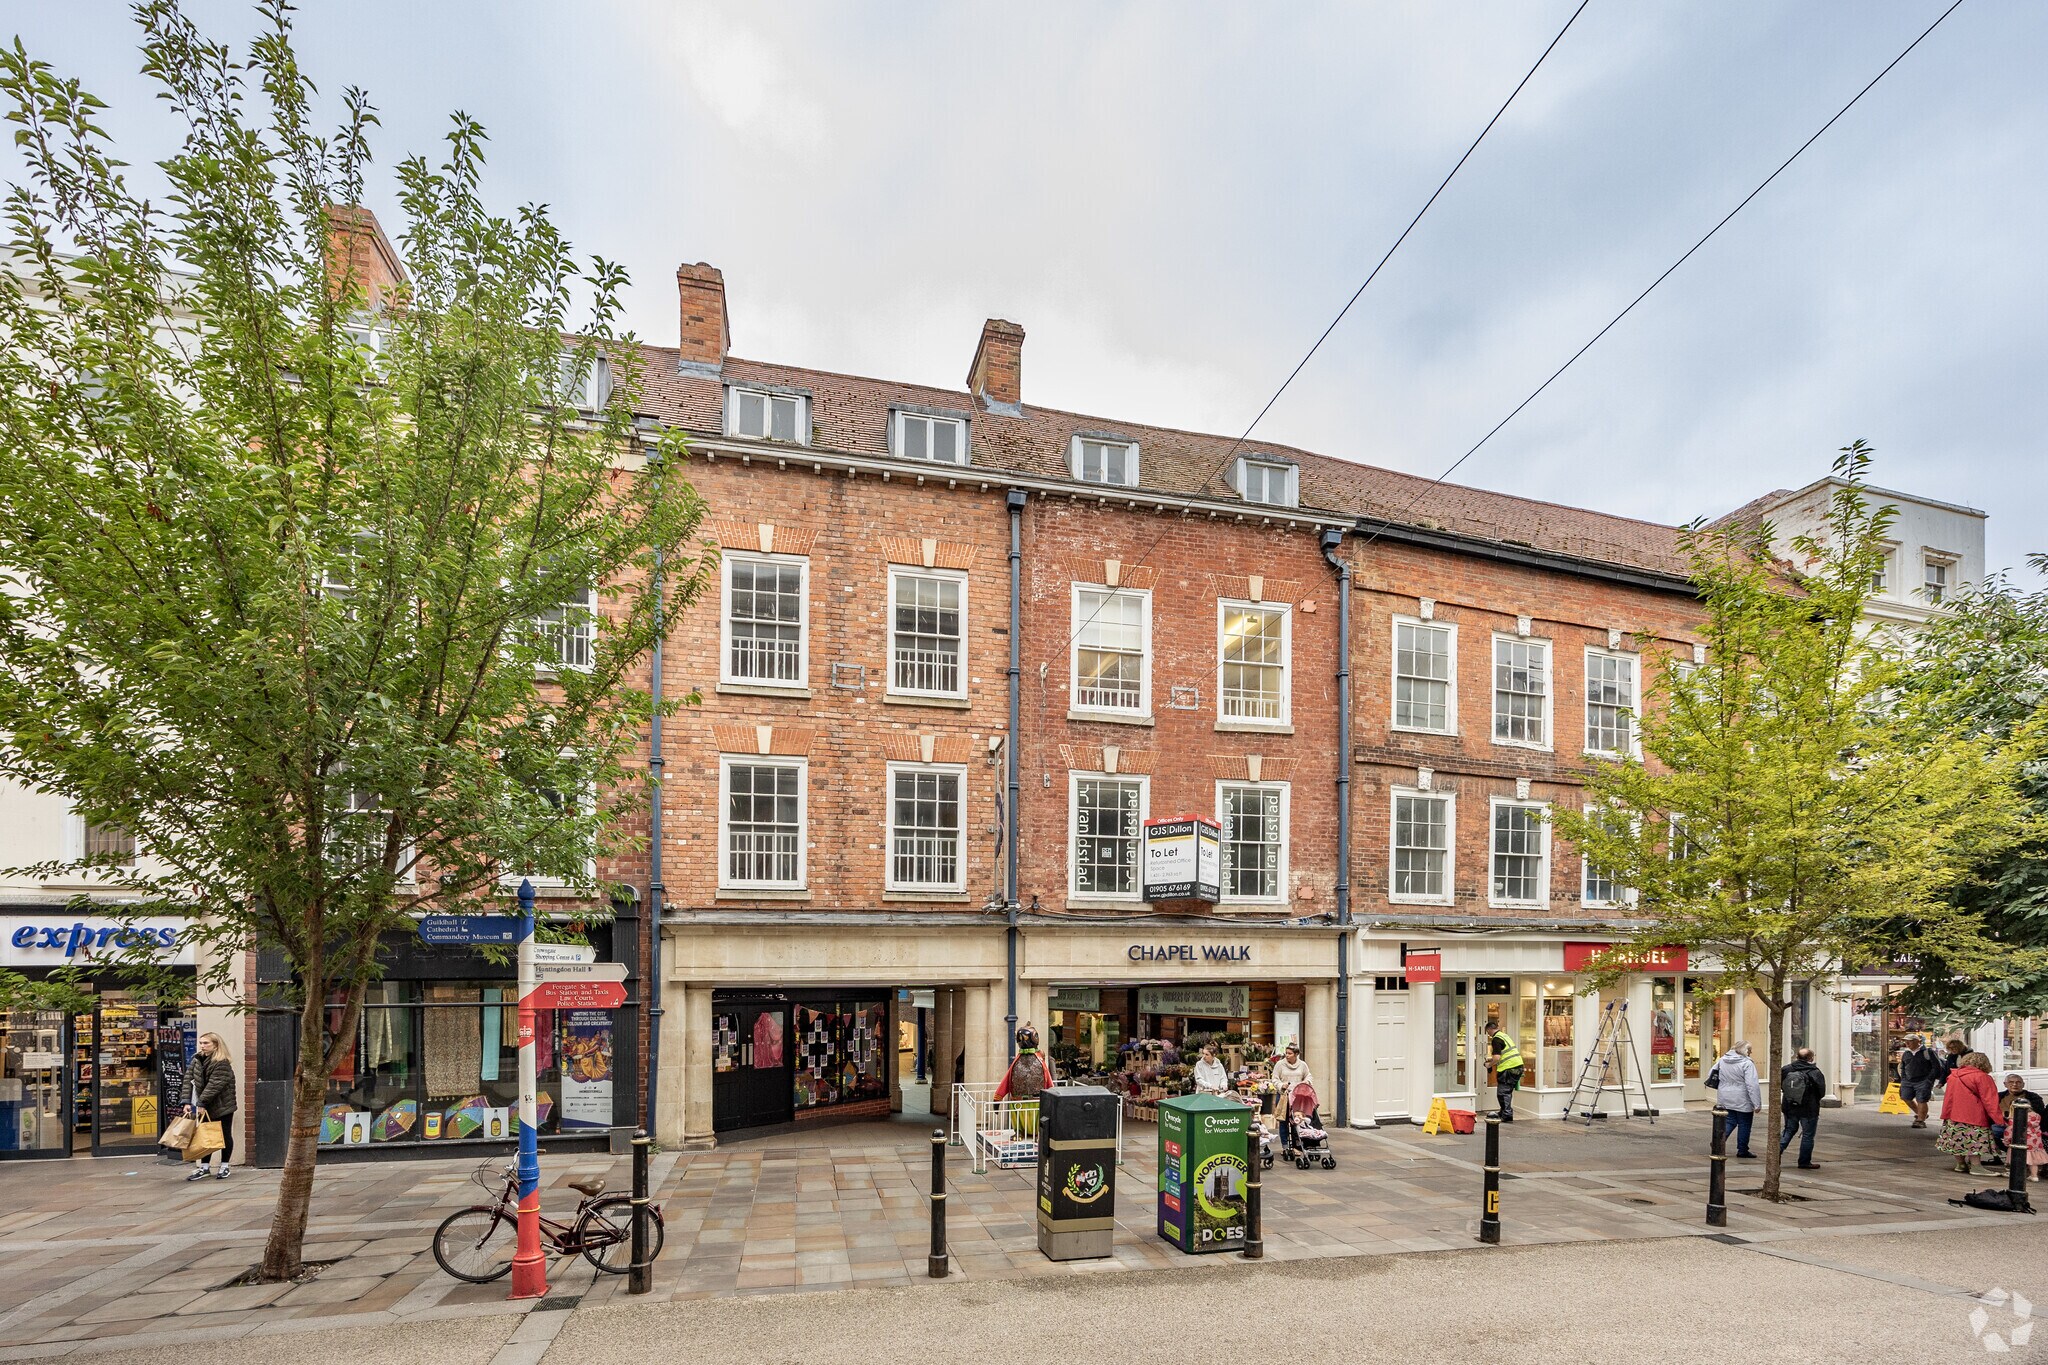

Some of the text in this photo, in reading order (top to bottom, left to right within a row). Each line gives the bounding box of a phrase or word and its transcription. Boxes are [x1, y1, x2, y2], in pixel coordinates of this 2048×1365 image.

[1124, 790, 1138, 864] randstad
[1150, 825, 1192, 836] GJS Dillon
[1266, 796, 1278, 868] randstad
[1078, 809, 1092, 885] randstad
[1150, 847, 1178, 858] To Let
[1222, 816, 1235, 890] randstad
[1168, 884, 1191, 892] 676169
[12, 922, 177, 957] express
[1128, 945, 1250, 960] CHAPEL WALK
[159, 1029, 180, 1040] TESCO
[1216, 1116, 1240, 1126] recycle
[1196, 1156, 1248, 1185] WORCESTER
